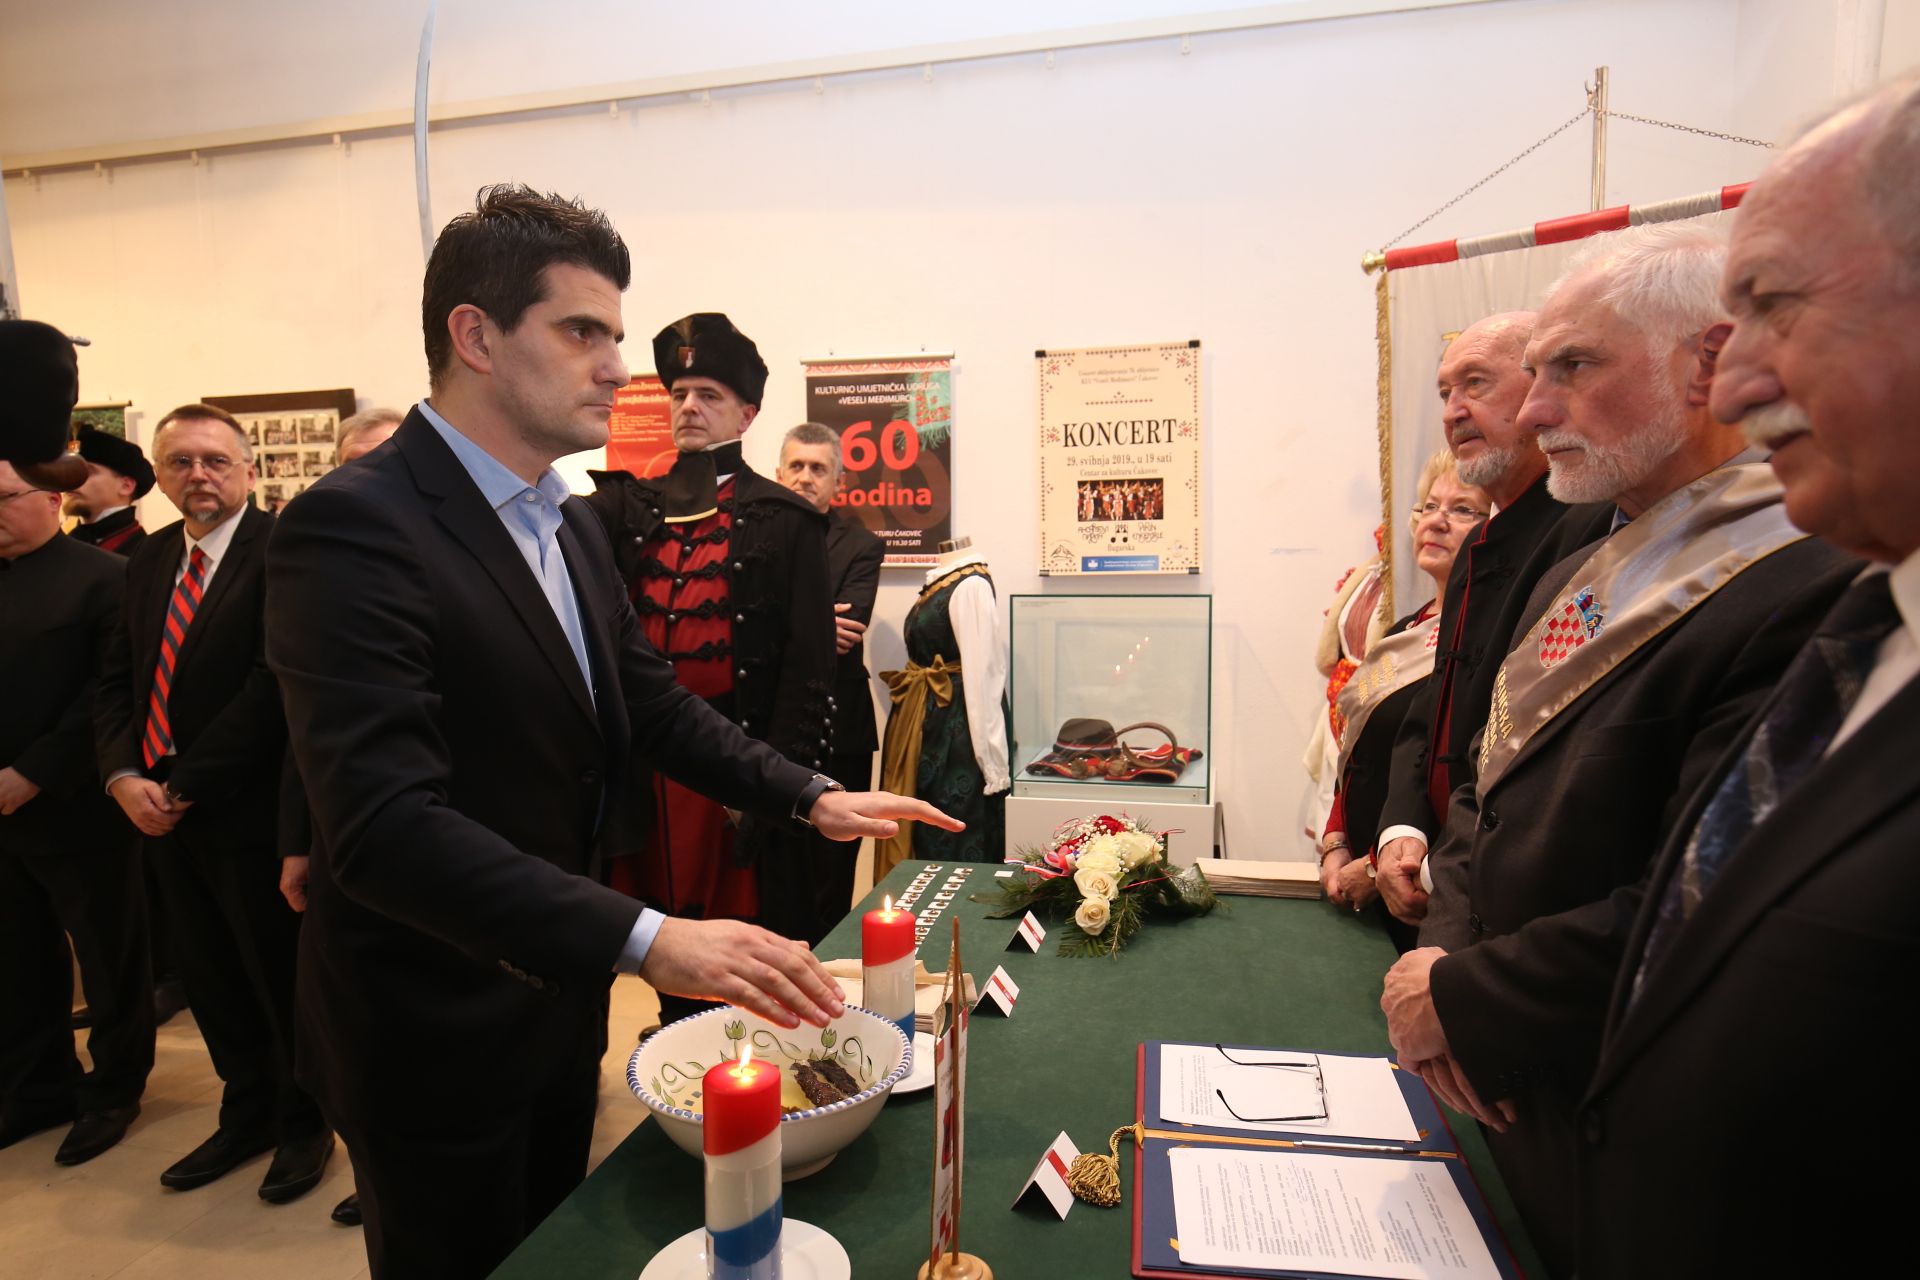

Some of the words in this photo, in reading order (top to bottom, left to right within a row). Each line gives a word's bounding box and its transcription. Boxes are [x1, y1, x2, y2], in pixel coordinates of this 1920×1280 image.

[814, 385, 856, 394] KULTURNO
[857, 382, 906, 393] UMJETNIČKA
[906, 382, 941, 391] UDRUGA
[1063, 418, 1177, 448] KONCERT
[842, 420, 920, 471] 60
[1066, 456, 1078, 466] 29.
[1080, 455, 1110, 467] svibnja
[1145, 453, 1154, 463] 19
[1156, 452, 1172, 462] sati
[1080, 468, 1100, 476] Centar
[1109, 468, 1132, 476] kulturu
[1133, 466, 1158, 474] Čakovec
[830, 482, 932, 507] Godina
[894, 529, 922, 537] ČAKOVEC
[1108, 544, 1136, 552] Bugarska
